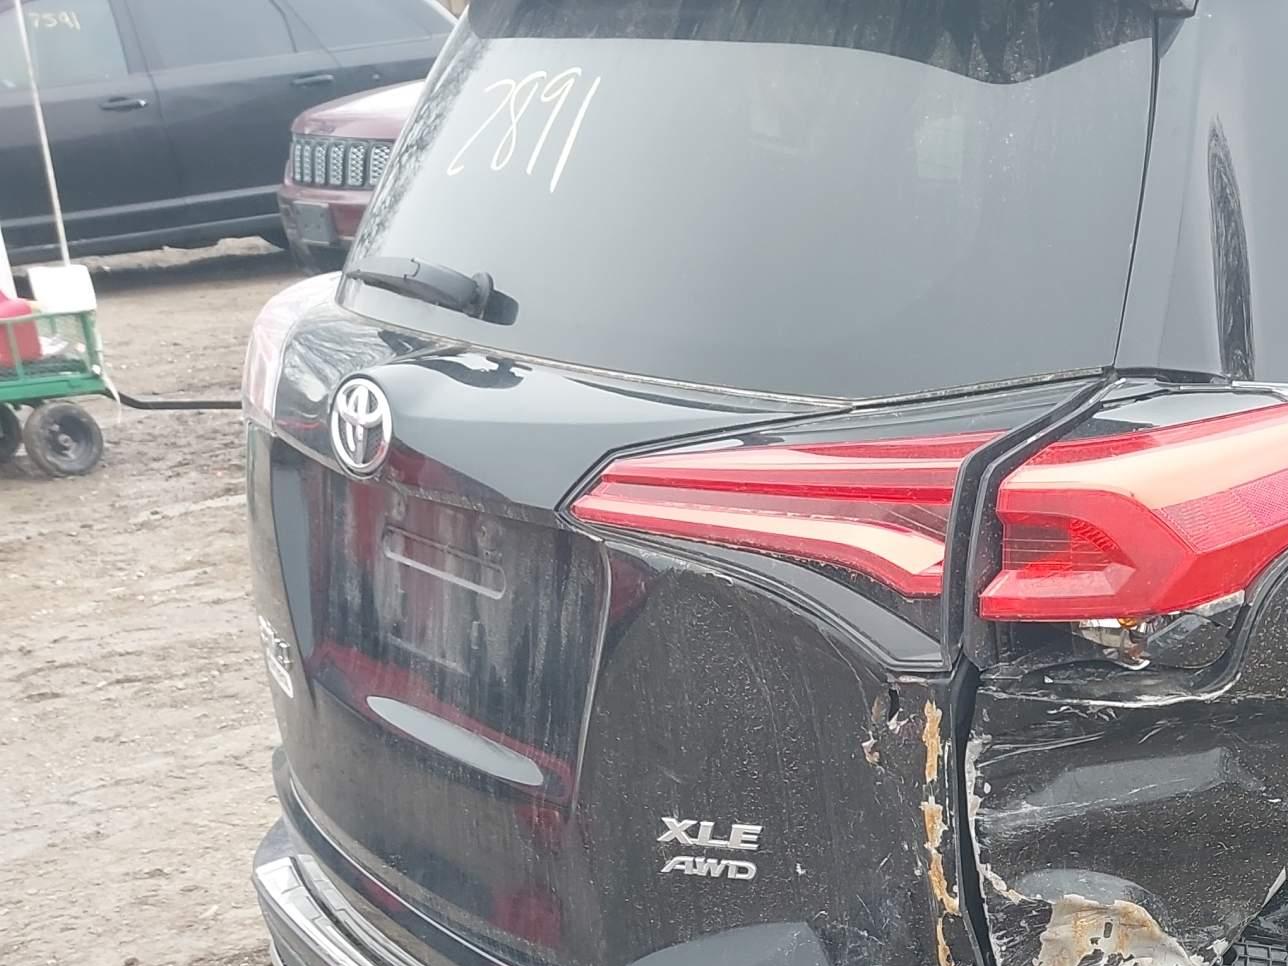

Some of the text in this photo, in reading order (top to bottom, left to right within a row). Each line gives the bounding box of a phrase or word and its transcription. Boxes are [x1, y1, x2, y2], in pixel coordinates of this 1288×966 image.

[447, 67, 600, 193] 2891
[657, 816, 763, 851] XLE
[660, 855, 757, 880] AWD
